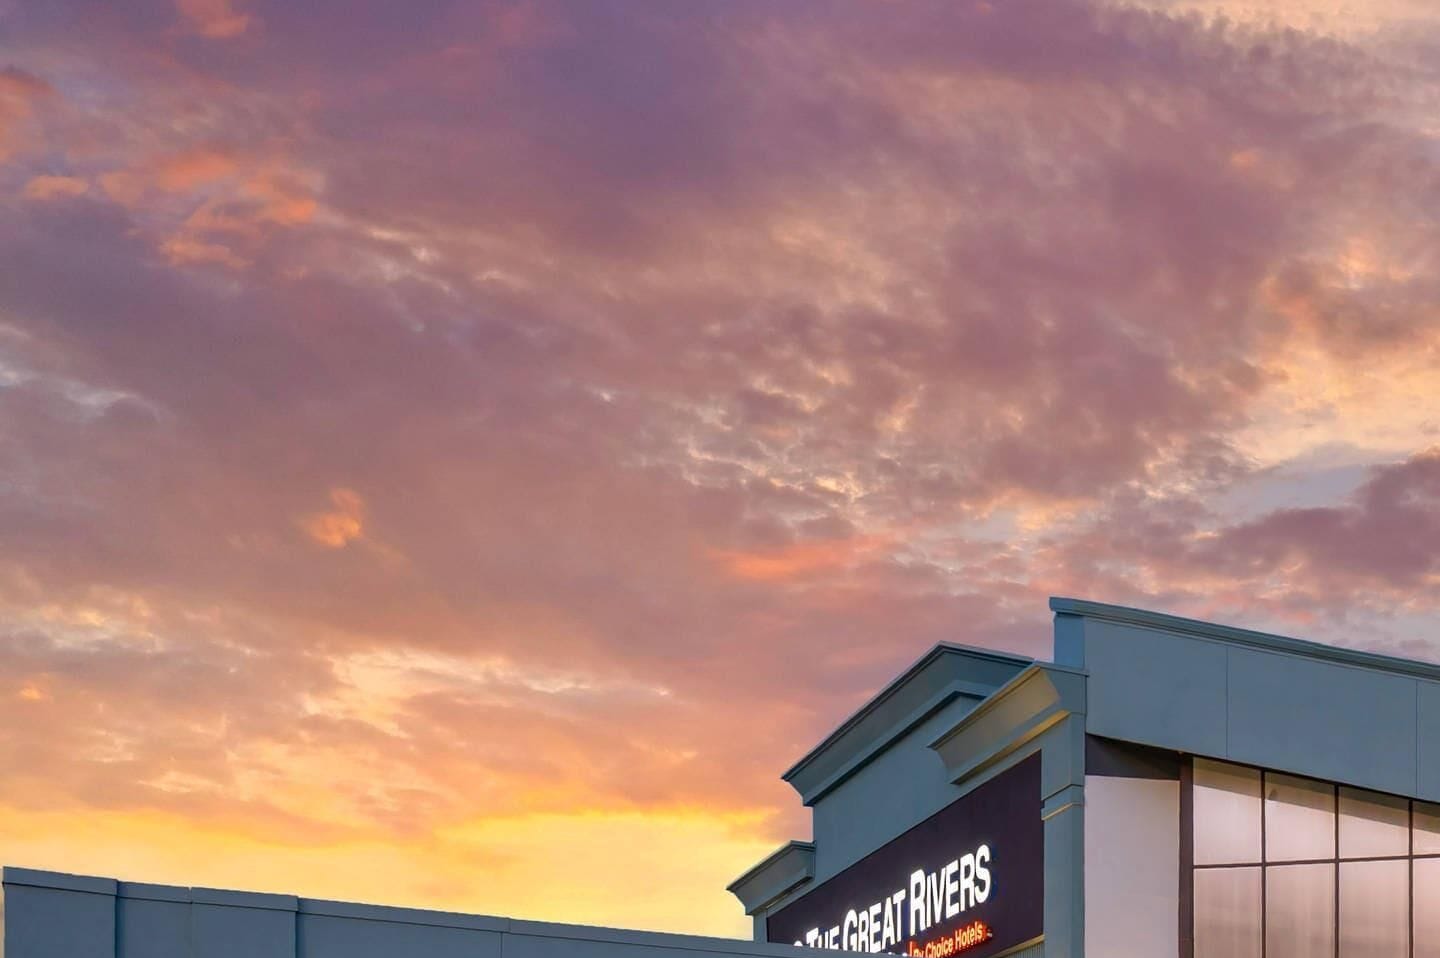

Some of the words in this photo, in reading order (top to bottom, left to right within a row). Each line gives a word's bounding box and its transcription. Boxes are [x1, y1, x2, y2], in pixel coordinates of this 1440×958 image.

[843, 889, 906, 953] GREAT
[910, 844, 991, 935] RIVERS
[955, 921, 982, 950] Hotels
